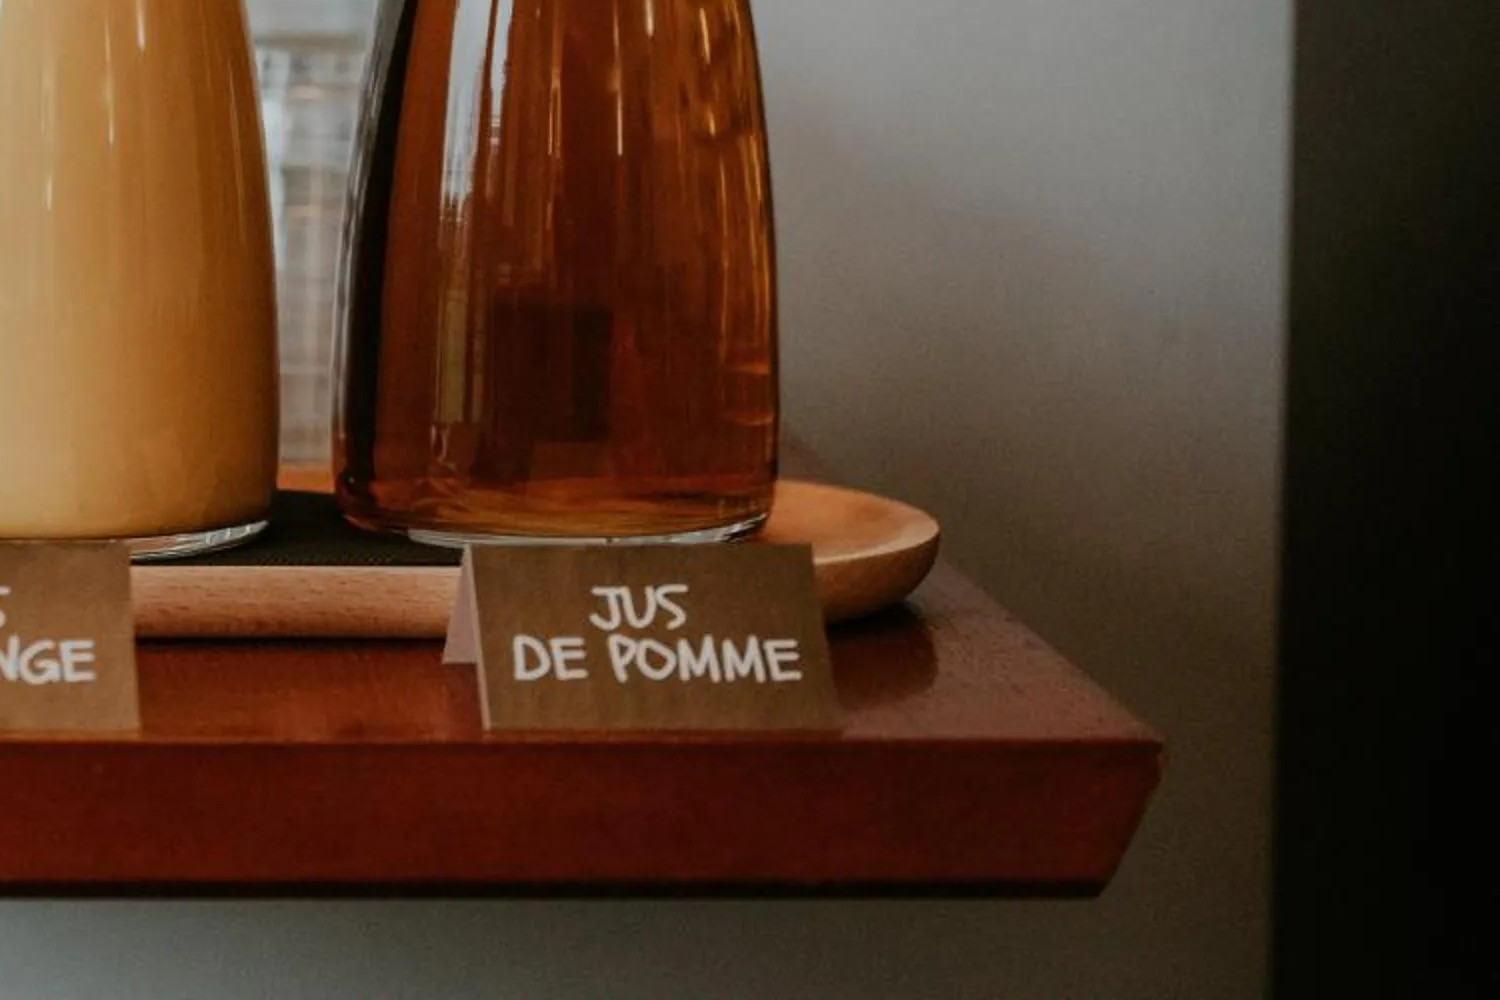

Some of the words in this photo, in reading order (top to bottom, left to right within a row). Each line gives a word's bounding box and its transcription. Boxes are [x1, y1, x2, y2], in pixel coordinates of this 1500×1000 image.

[589, 583, 690, 632] JUS
[512, 634, 589, 682] DE
[606, 633, 803, 684] POMME
